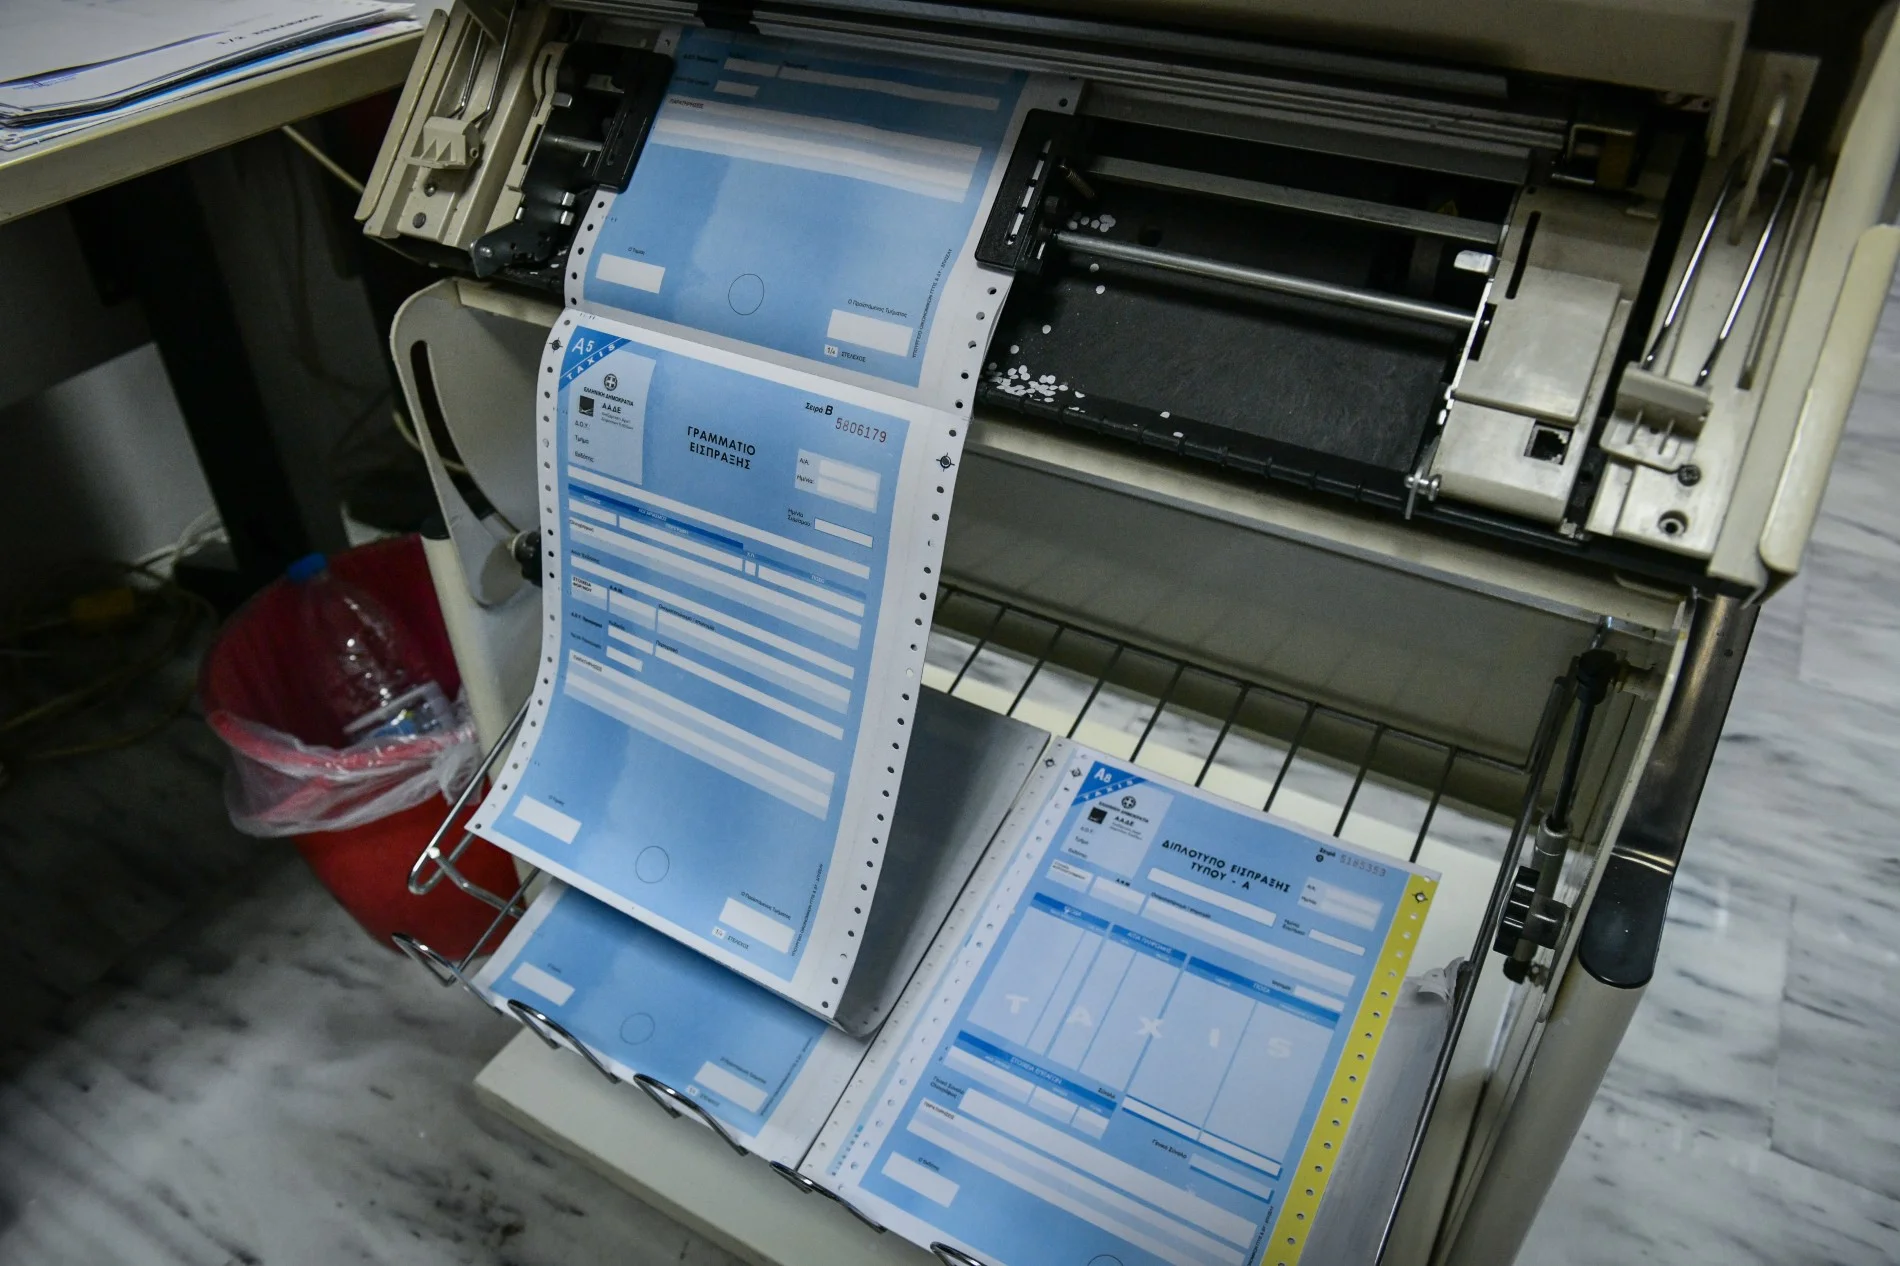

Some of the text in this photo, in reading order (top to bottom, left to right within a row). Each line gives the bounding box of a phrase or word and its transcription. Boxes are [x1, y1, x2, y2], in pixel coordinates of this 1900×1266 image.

[841, 351, 867, 363] ΣΤΕΛΕΧΟΣ
[583, 386, 634, 407] ΕΛΛΗΝΙΚΗ ΔΗΜΟΚΡΑΤΙΑ
[805, 402, 823, 415] Σειρά
[687, 425, 756, 456] ΓΡΑΜΜΑΤΙΟ
[834, 416, 888, 444] 5806179
[689, 442, 752, 470] ΕΙΣΠΡΑΞΗΣ
[1162, 838, 1292, 894] ΔΙΠΛΟΤΥΠΟ ΕΙΣΠΡΑΞΗΣ
[1191, 860, 1228, 882] ΤΥΠΟΥ
